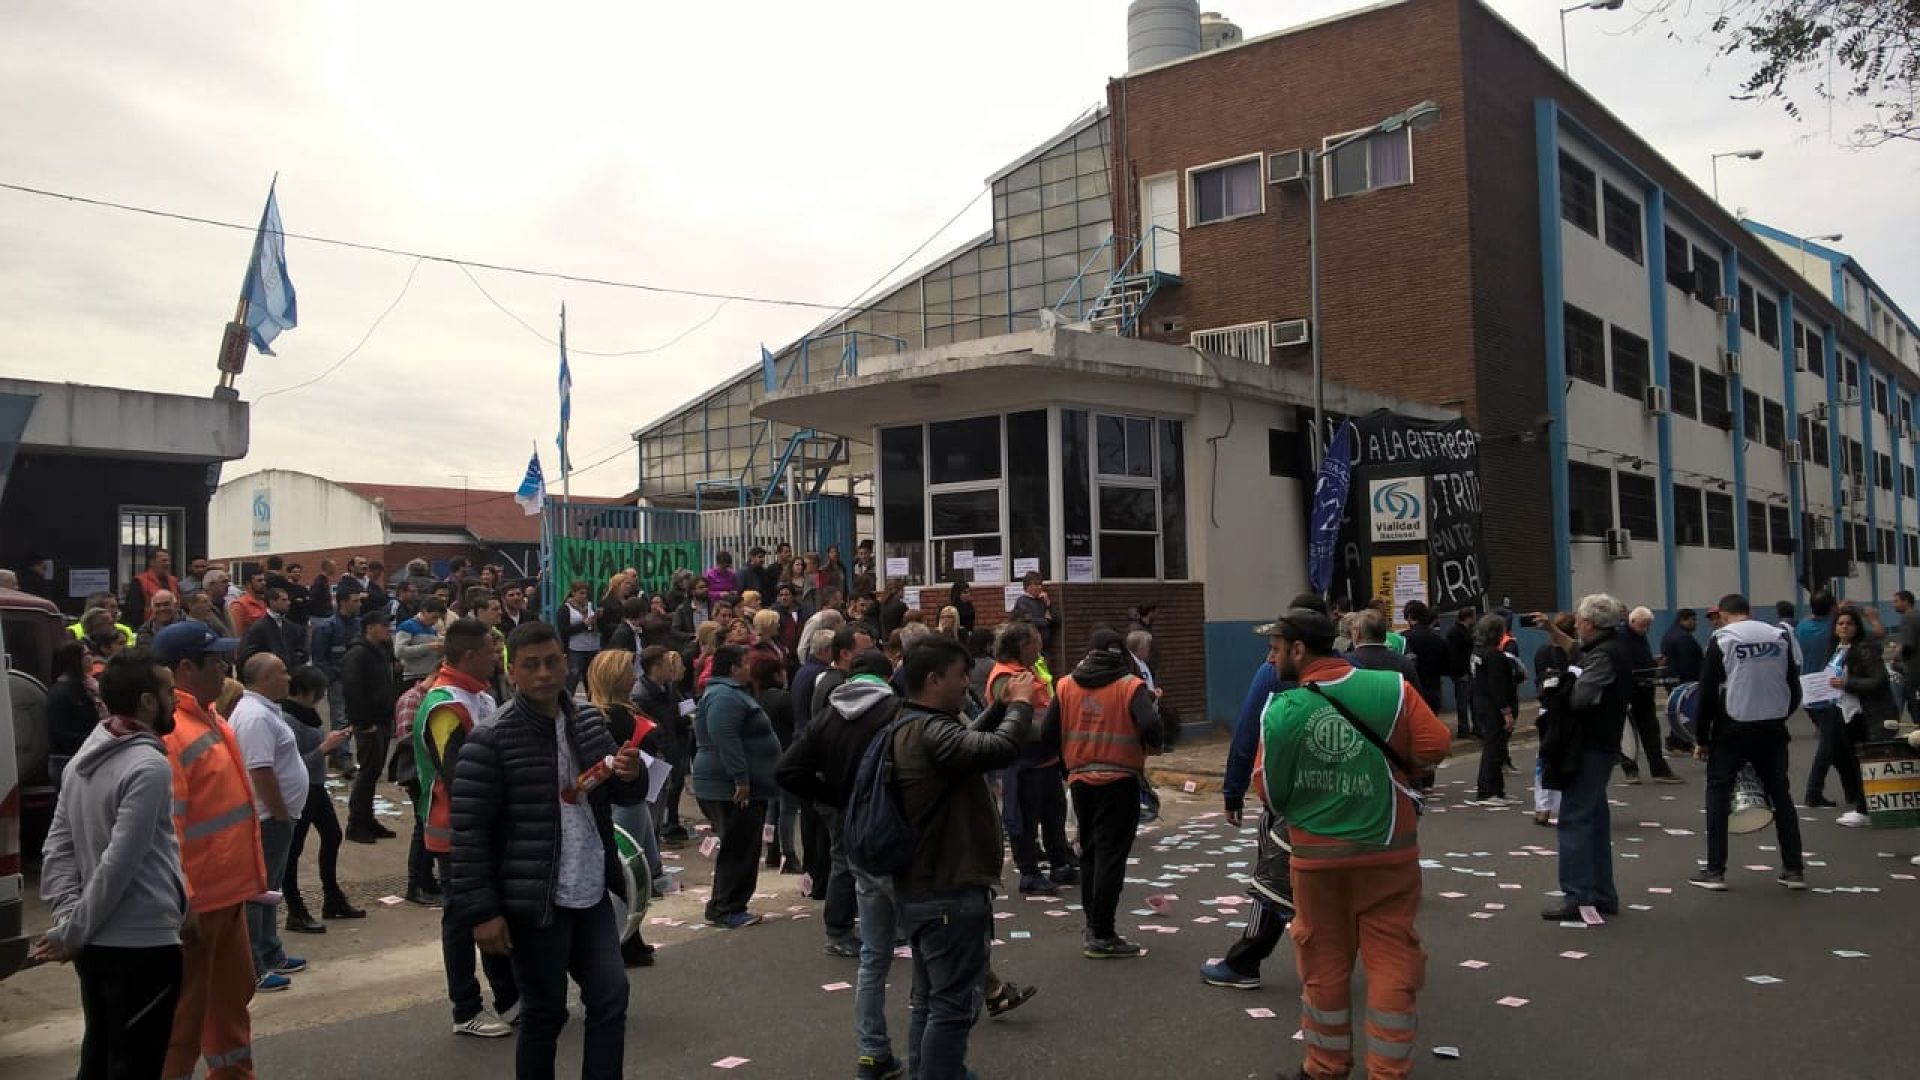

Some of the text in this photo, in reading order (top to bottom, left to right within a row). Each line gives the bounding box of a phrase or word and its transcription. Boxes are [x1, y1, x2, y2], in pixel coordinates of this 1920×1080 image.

[1375, 520, 1421, 532] Vialidad
[567, 545, 690, 578] VIALIDAD
[1318, 719, 1353, 751] ATE
